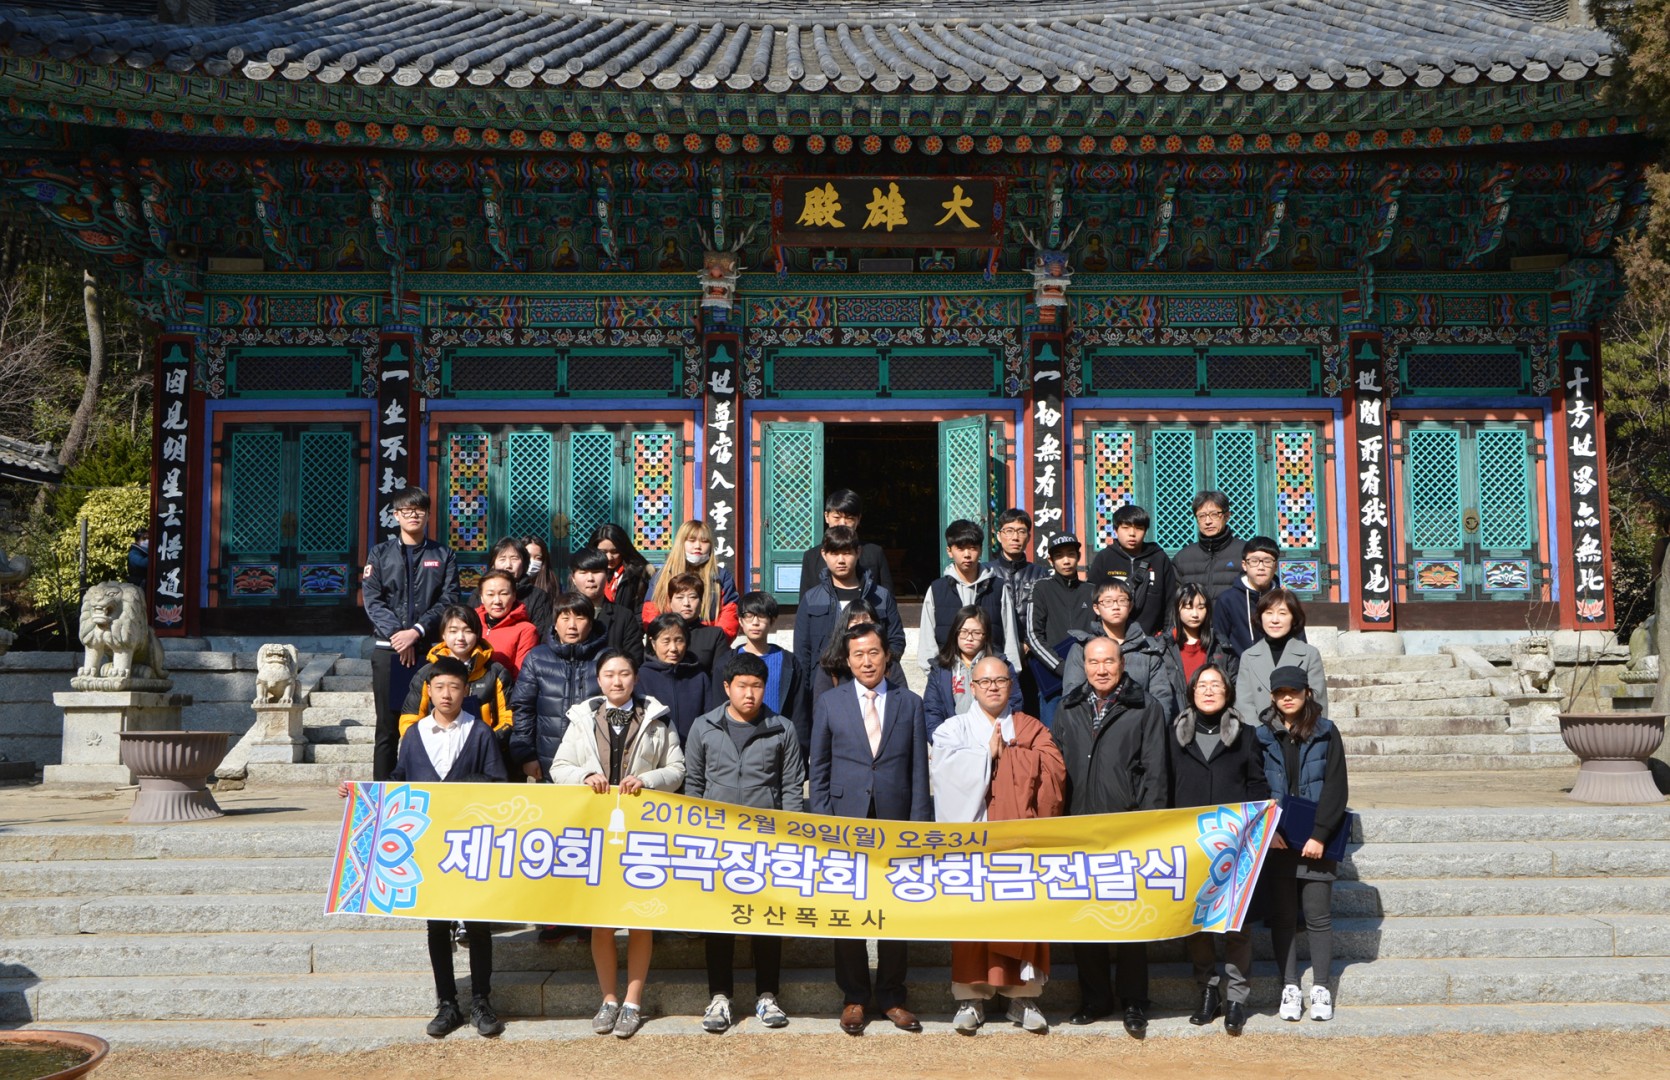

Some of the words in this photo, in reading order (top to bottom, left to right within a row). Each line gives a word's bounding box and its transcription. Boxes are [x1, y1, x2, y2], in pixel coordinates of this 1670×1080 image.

[707, 368, 735, 568] 世尊當入雪山
[439, 825, 604, 886] 제19회
[620, 830, 868, 901] 동곡장학회
[885, 845, 1188, 902] 장학금전달식
[641, 801, 726, 830] 2016년
[737, 813, 776, 835] 2월
[787, 820, 886, 850] 29일(월)
[895, 829, 988, 851] 오후3시
